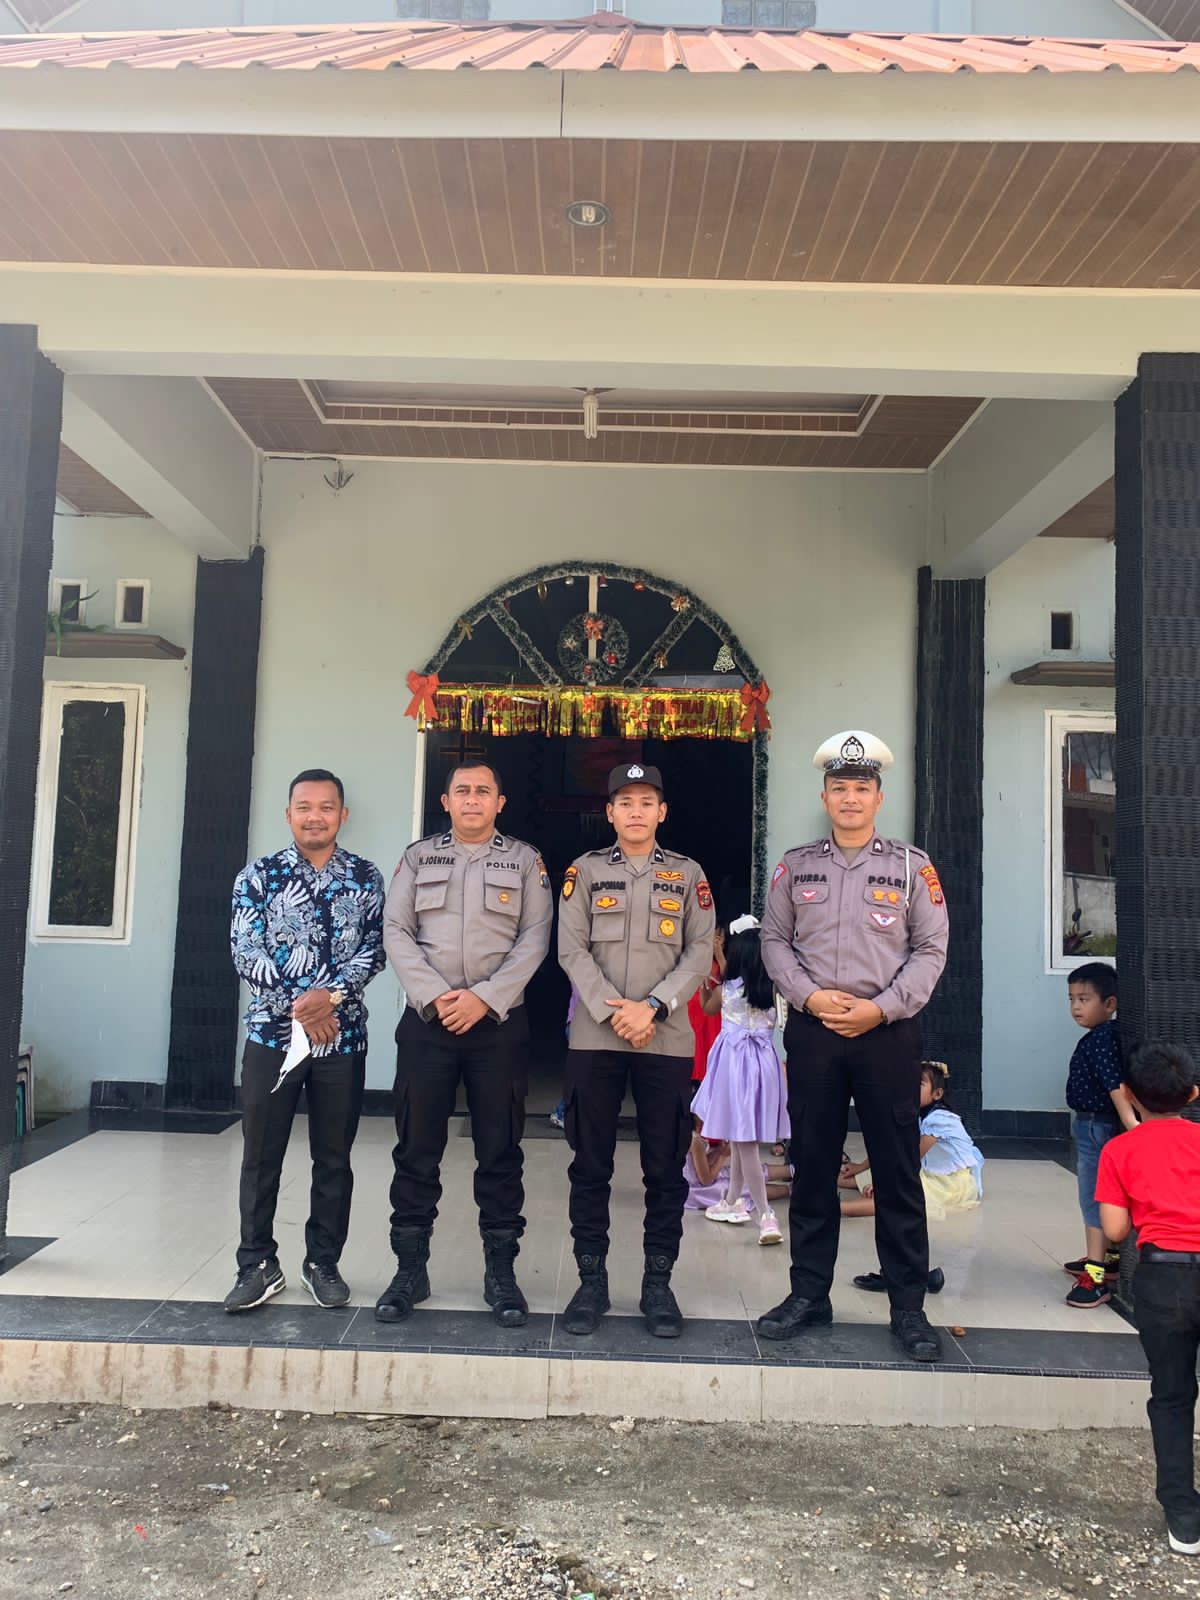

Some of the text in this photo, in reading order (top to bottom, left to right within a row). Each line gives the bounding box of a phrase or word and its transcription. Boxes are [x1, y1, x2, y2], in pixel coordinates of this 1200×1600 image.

[486, 861, 520, 871] POLISI
[794, 874, 828, 884] PURBA
[868, 875, 906, 889] POLRI
[653, 882, 685, 896] POLRI
